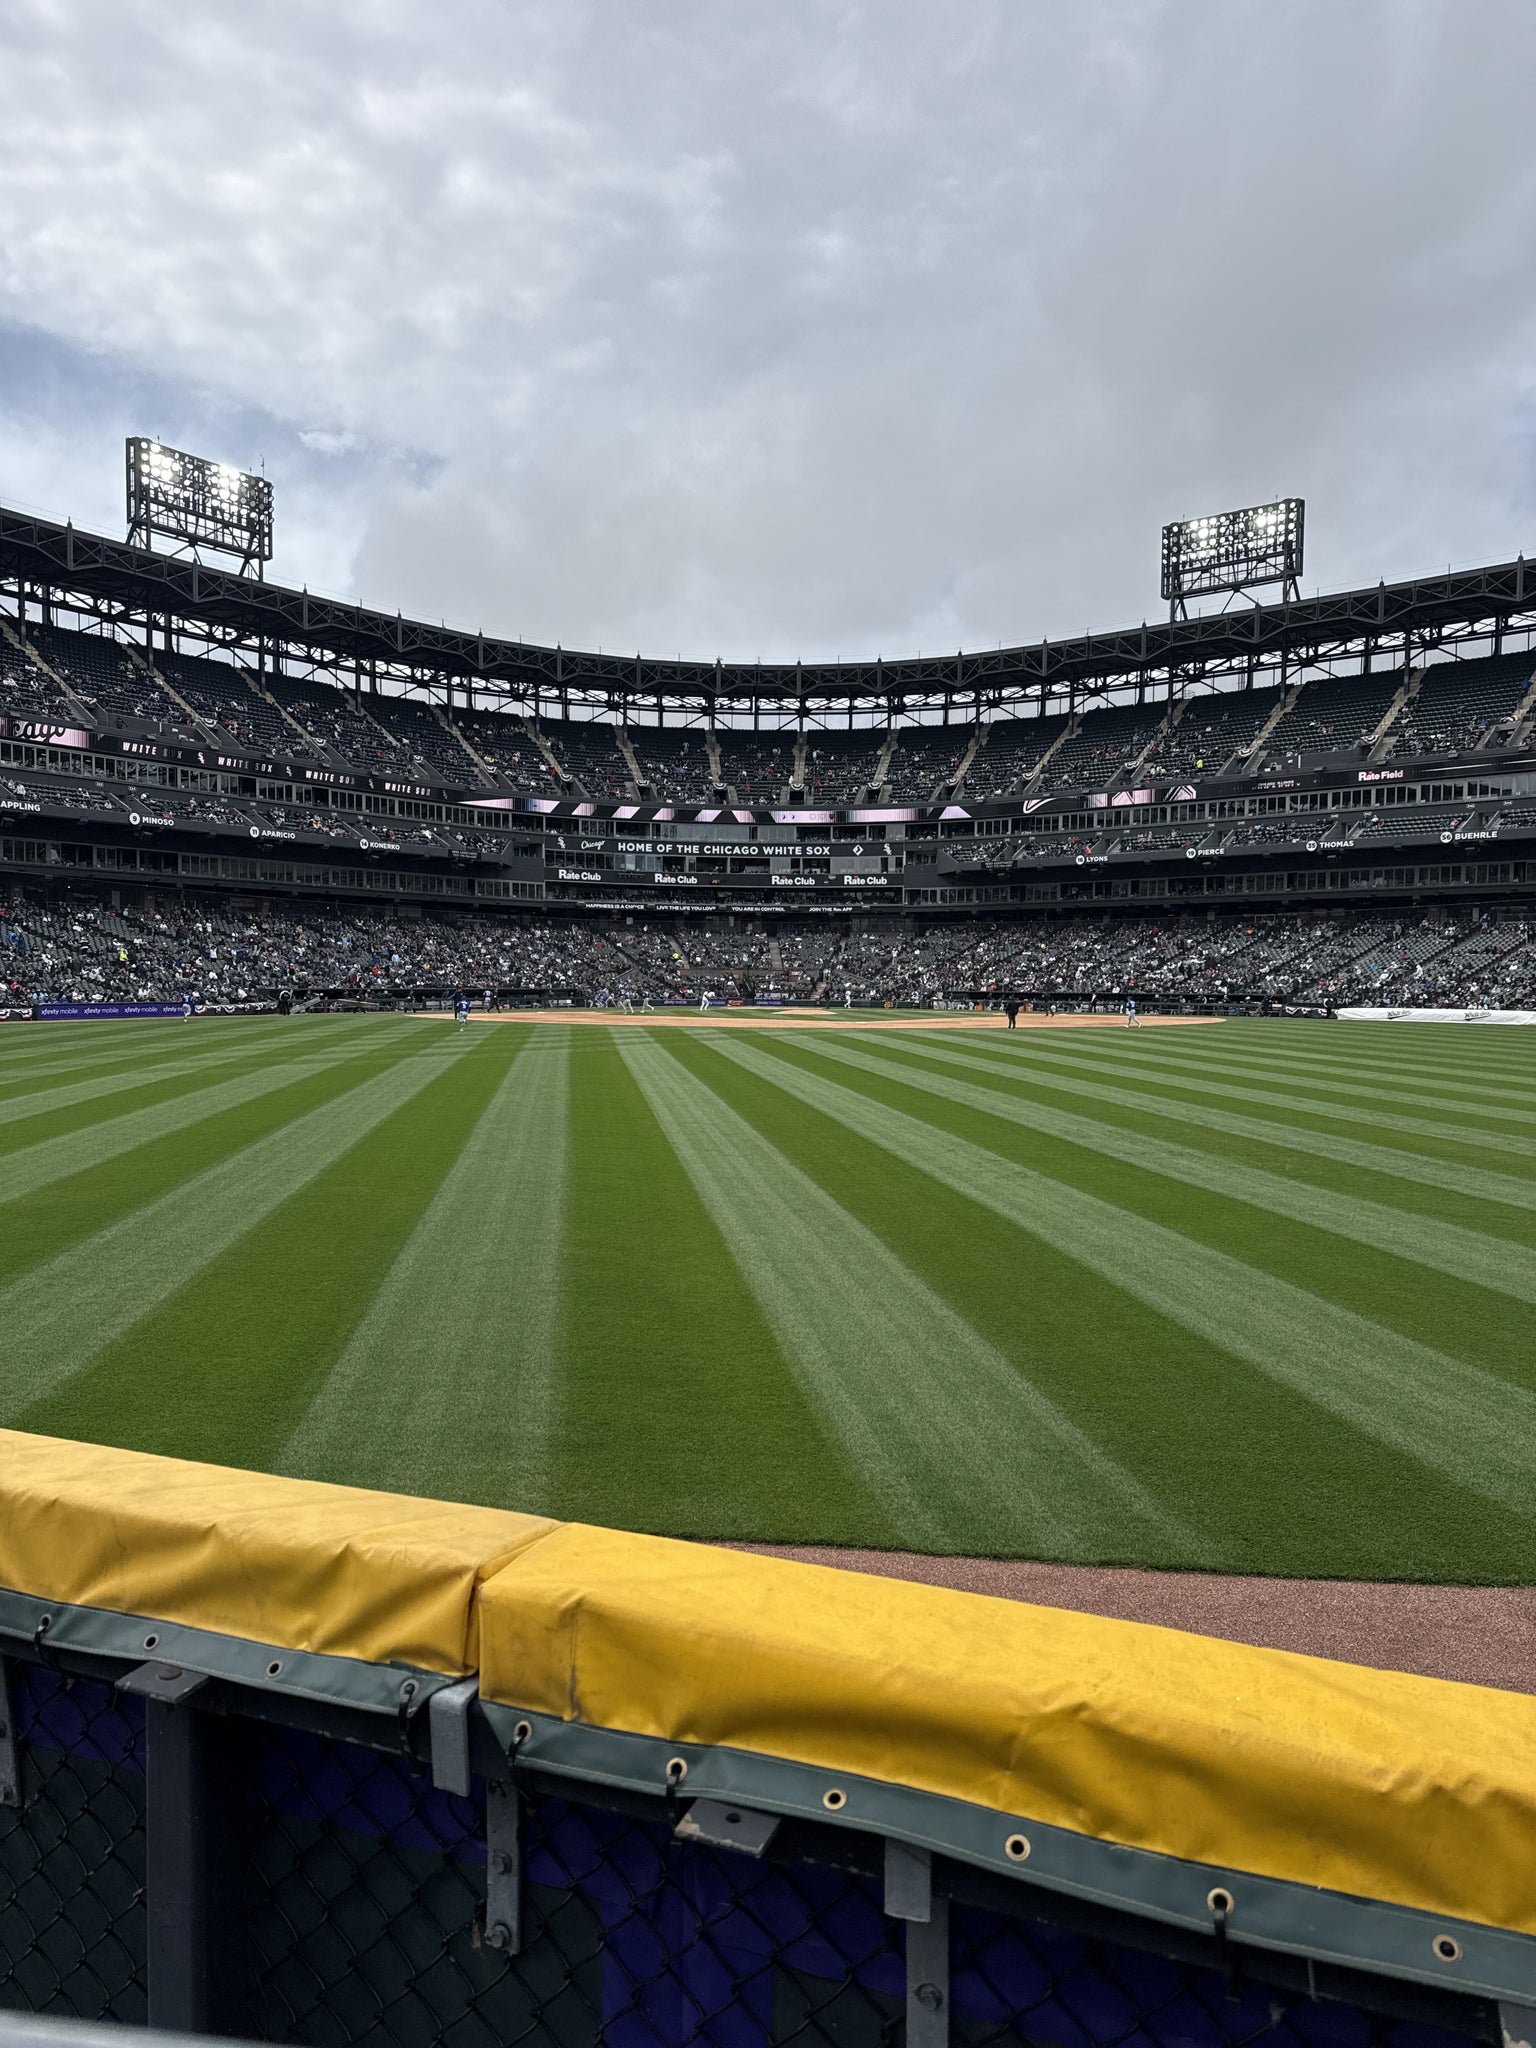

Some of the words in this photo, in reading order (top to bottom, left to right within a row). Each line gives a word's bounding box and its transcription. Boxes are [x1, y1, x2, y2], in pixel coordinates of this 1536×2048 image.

[122, 741, 157, 756] WHITE
[218, 756, 248, 769] WHITE
[305, 770, 334, 782] WHITE
[1358, 770, 1380, 781] Rate
[1380, 769, 1404, 780] Field
[384, 782, 411, 794] WHITE
[0, 800, 41, 812] APPLING
[142, 816, 175, 827] MINOSO
[261, 830, 296, 839] APARICIO
[1454, 831, 1498, 840] BUEHRLE
[369, 841, 400, 850] KONERKO
[581, 840, 606, 850] Chicago
[618, 842, 653, 852] HOME
[656, 844, 673, 853] OF
[676, 844, 700, 854] THE
[703, 845, 759, 855] CHICAGO
[763, 846, 802, 855] WHITE
[806, 846, 830, 855] SOX
[1320, 840, 1355, 848] THOMAS
[1197, 848, 1225, 856] PIERCE
[1086, 855, 1109, 863] LYONS
[558, 869, 580, 880] Rate
[581, 872, 602, 881] Club
[654, 873, 676, 883] Rate
[677, 876, 698, 884] Club
[771, 875, 793, 885] Rate
[794, 877, 816, 885] Club
[843, 875, 866, 885] Rate
[866, 877, 887, 885] Club
[40, 1008, 59, 1016] xfinity
[59, 1007, 78, 1015] mobile
[83, 1007, 101, 1015] xfinity
[124, 1007, 141, 1015] xfinity
